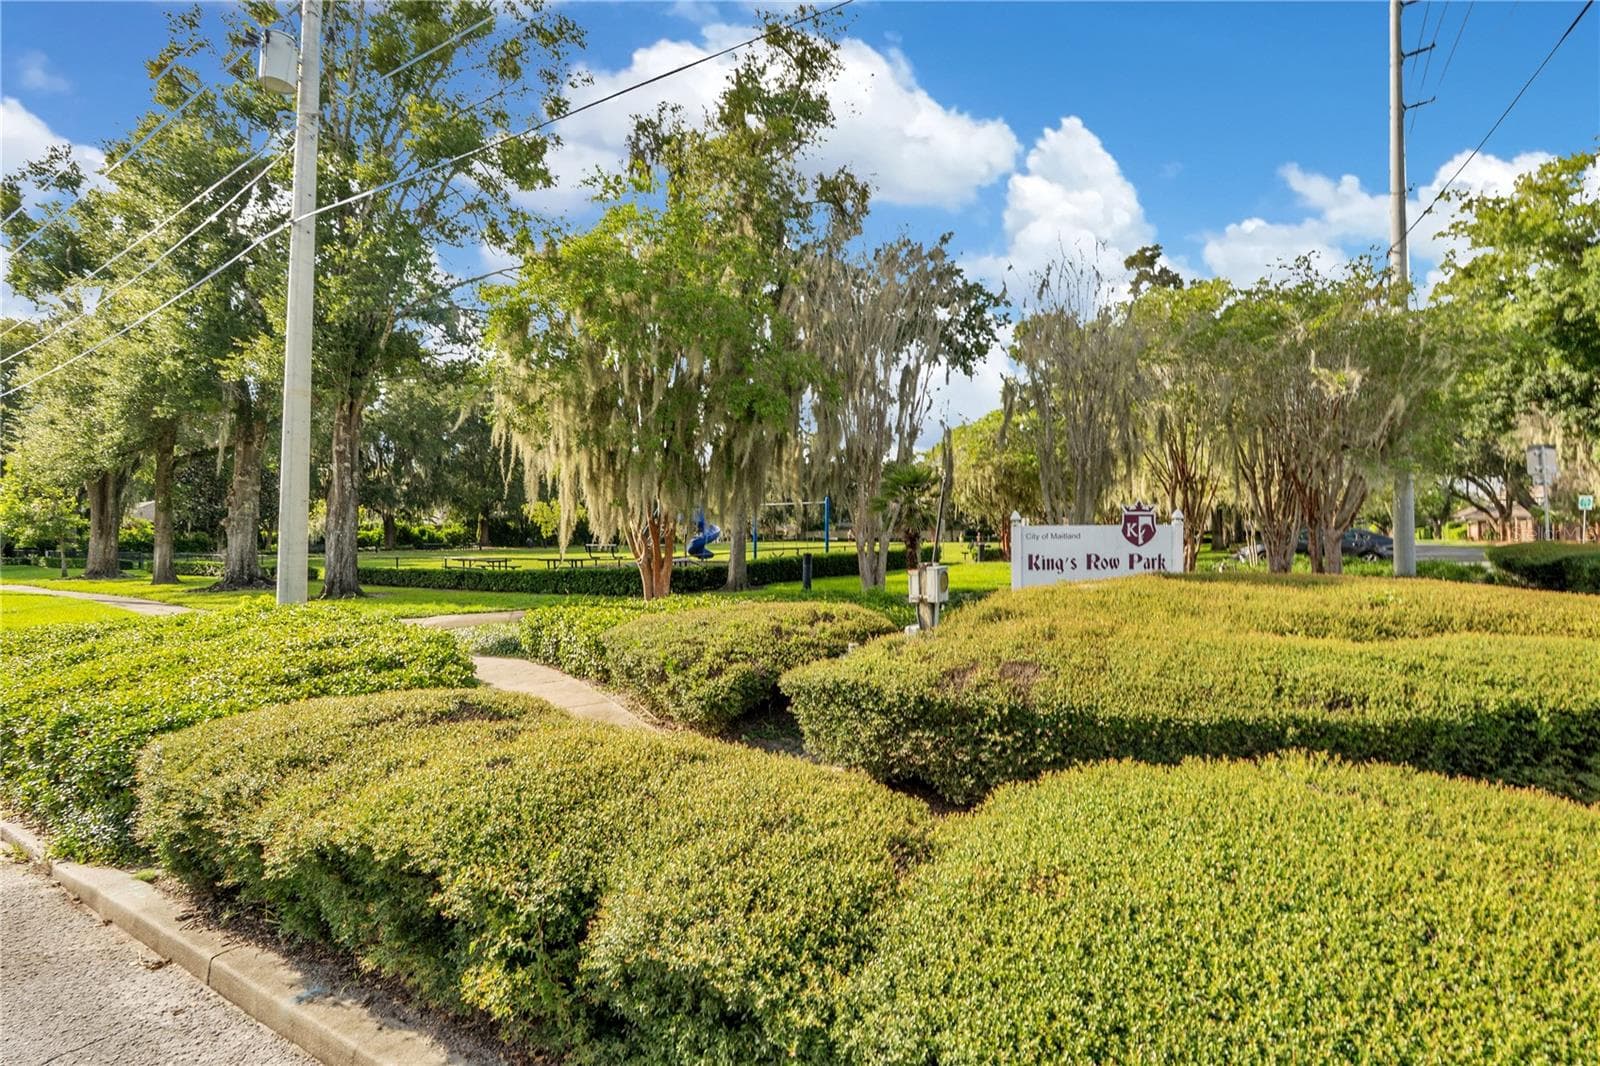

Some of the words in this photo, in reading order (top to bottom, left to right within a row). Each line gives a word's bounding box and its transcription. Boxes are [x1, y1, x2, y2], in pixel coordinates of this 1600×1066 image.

[1025, 532, 1040, 541] City
[1041, 532, 1049, 540] of
[1050, 532, 1081, 540] Maitland
[1028, 553, 1078, 575] King's
[1086, 553, 1120, 571] Row
[1128, 553, 1167, 571] Park
